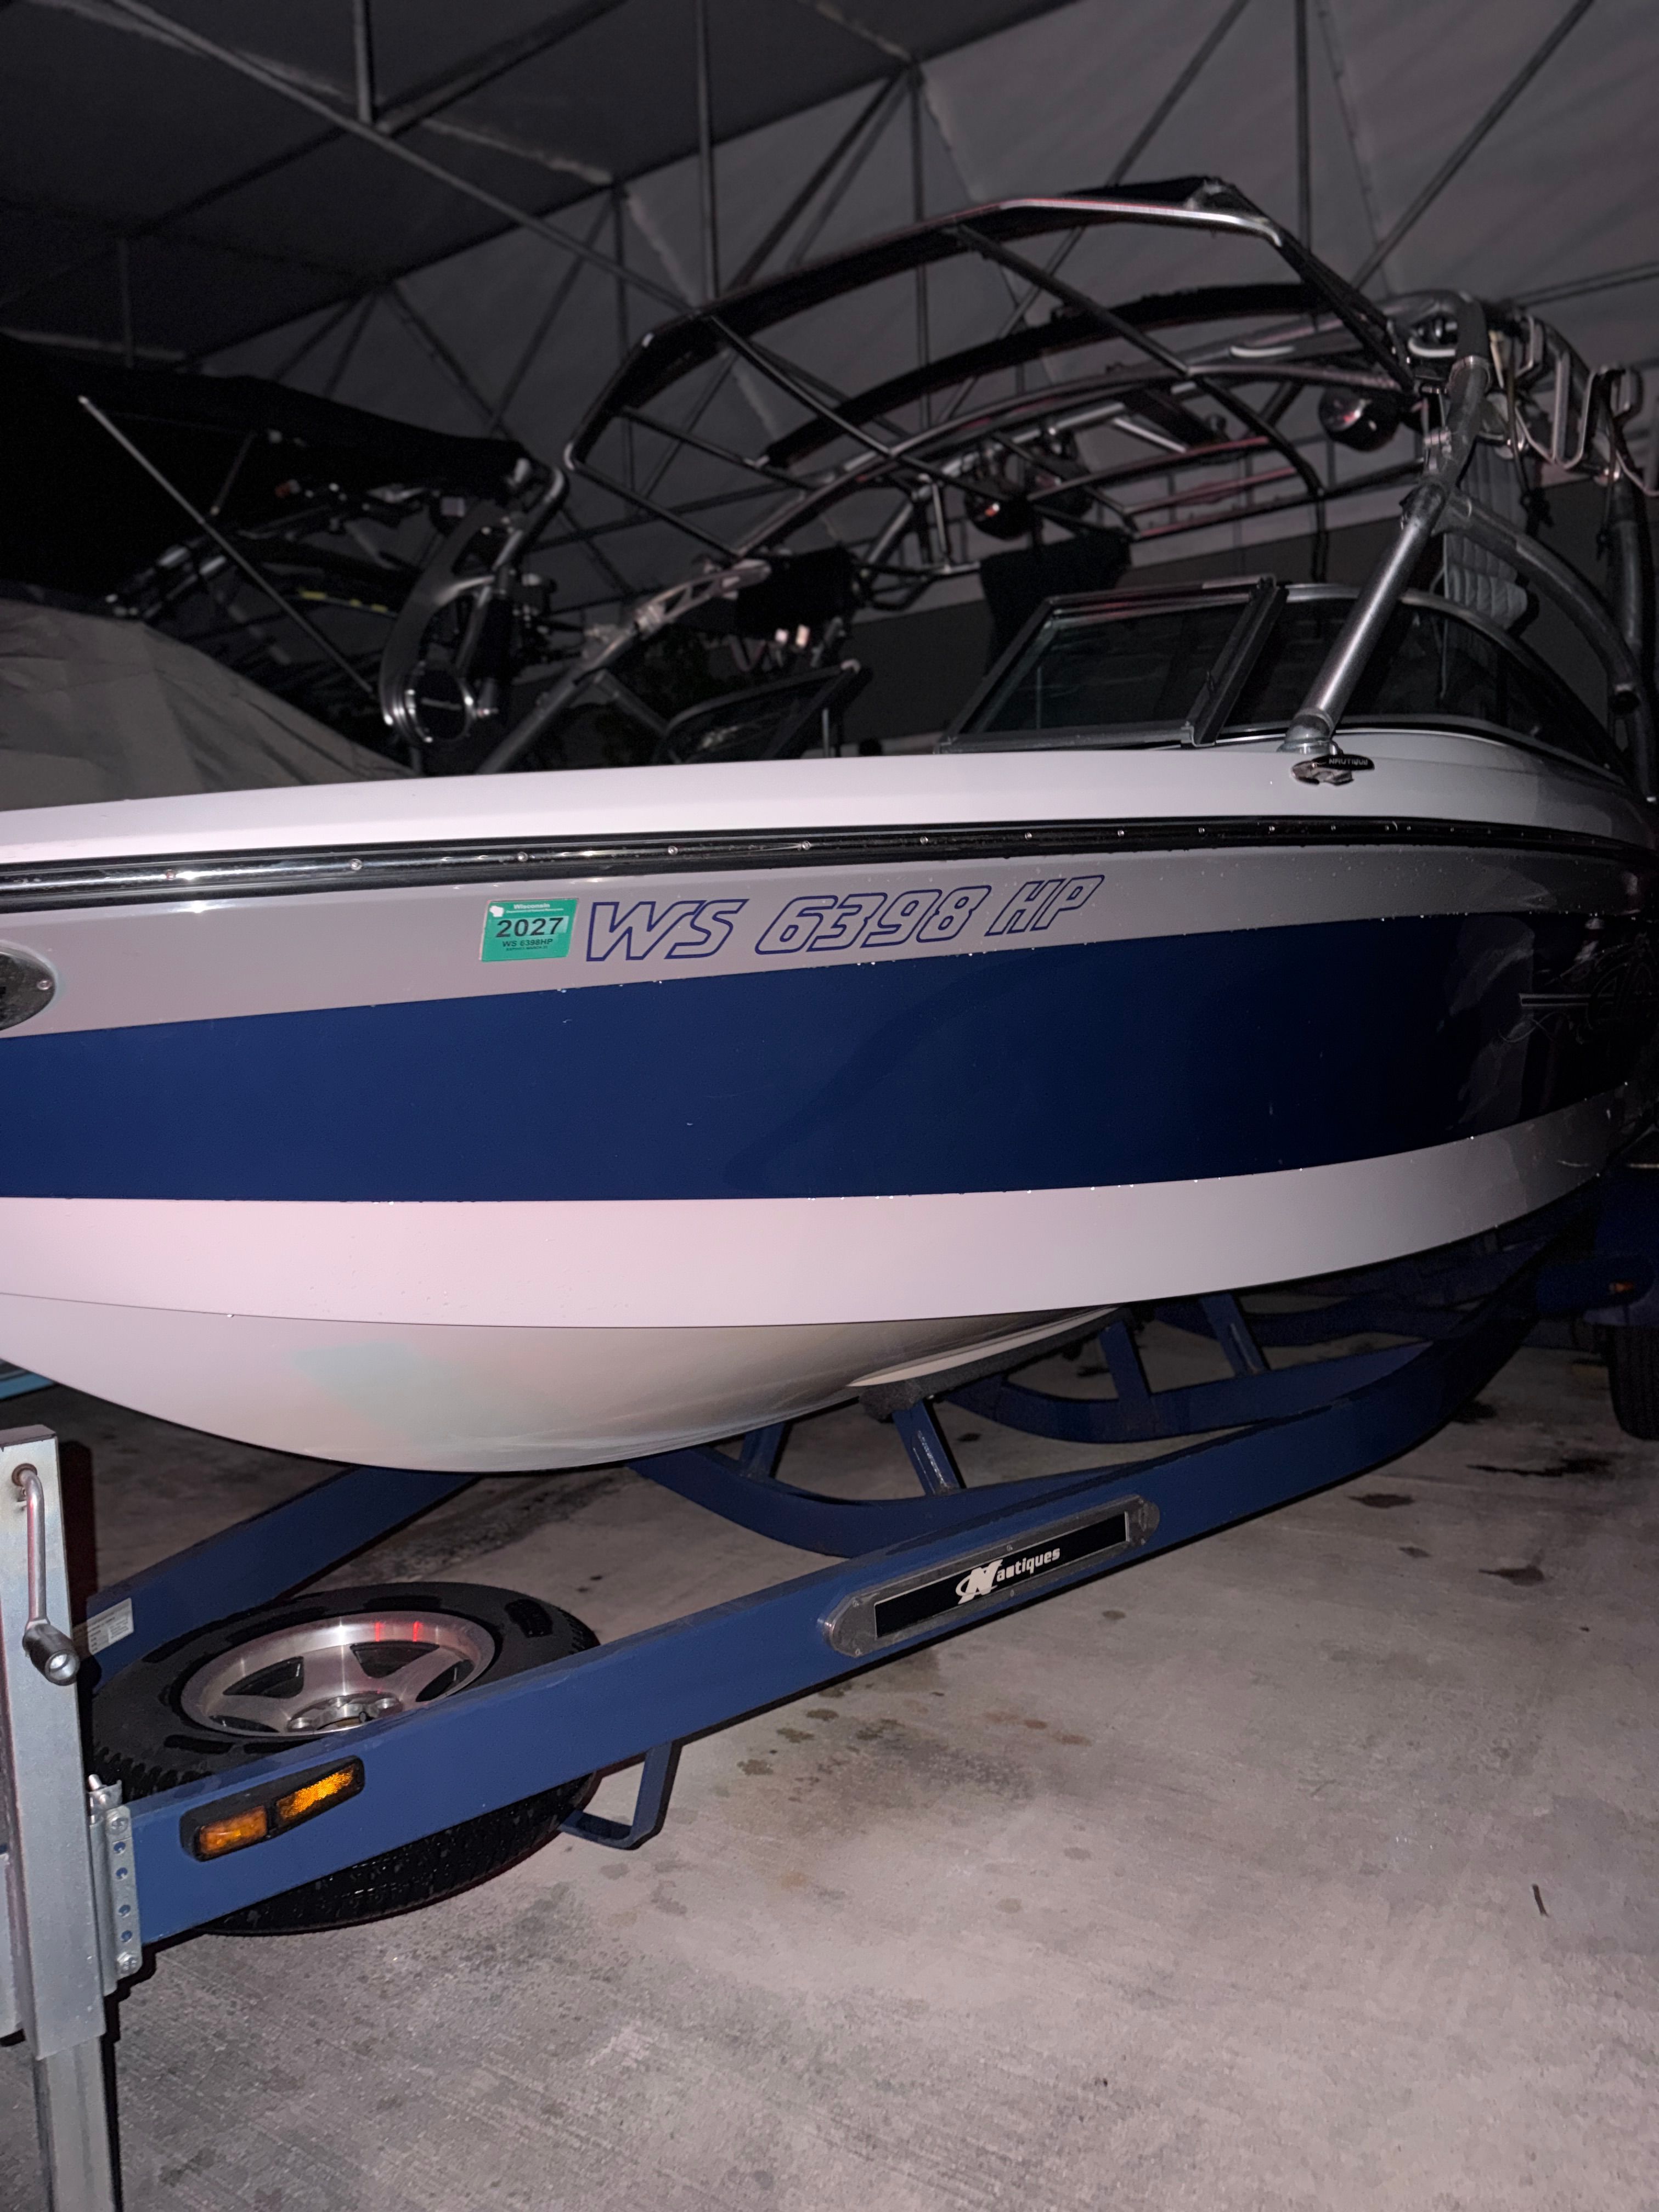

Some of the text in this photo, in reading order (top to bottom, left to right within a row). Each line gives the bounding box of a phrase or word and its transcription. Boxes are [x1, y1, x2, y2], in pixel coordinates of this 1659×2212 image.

[496, 917, 564, 938] 2027
[586, 874, 1105, 962] WS 6398 HP
